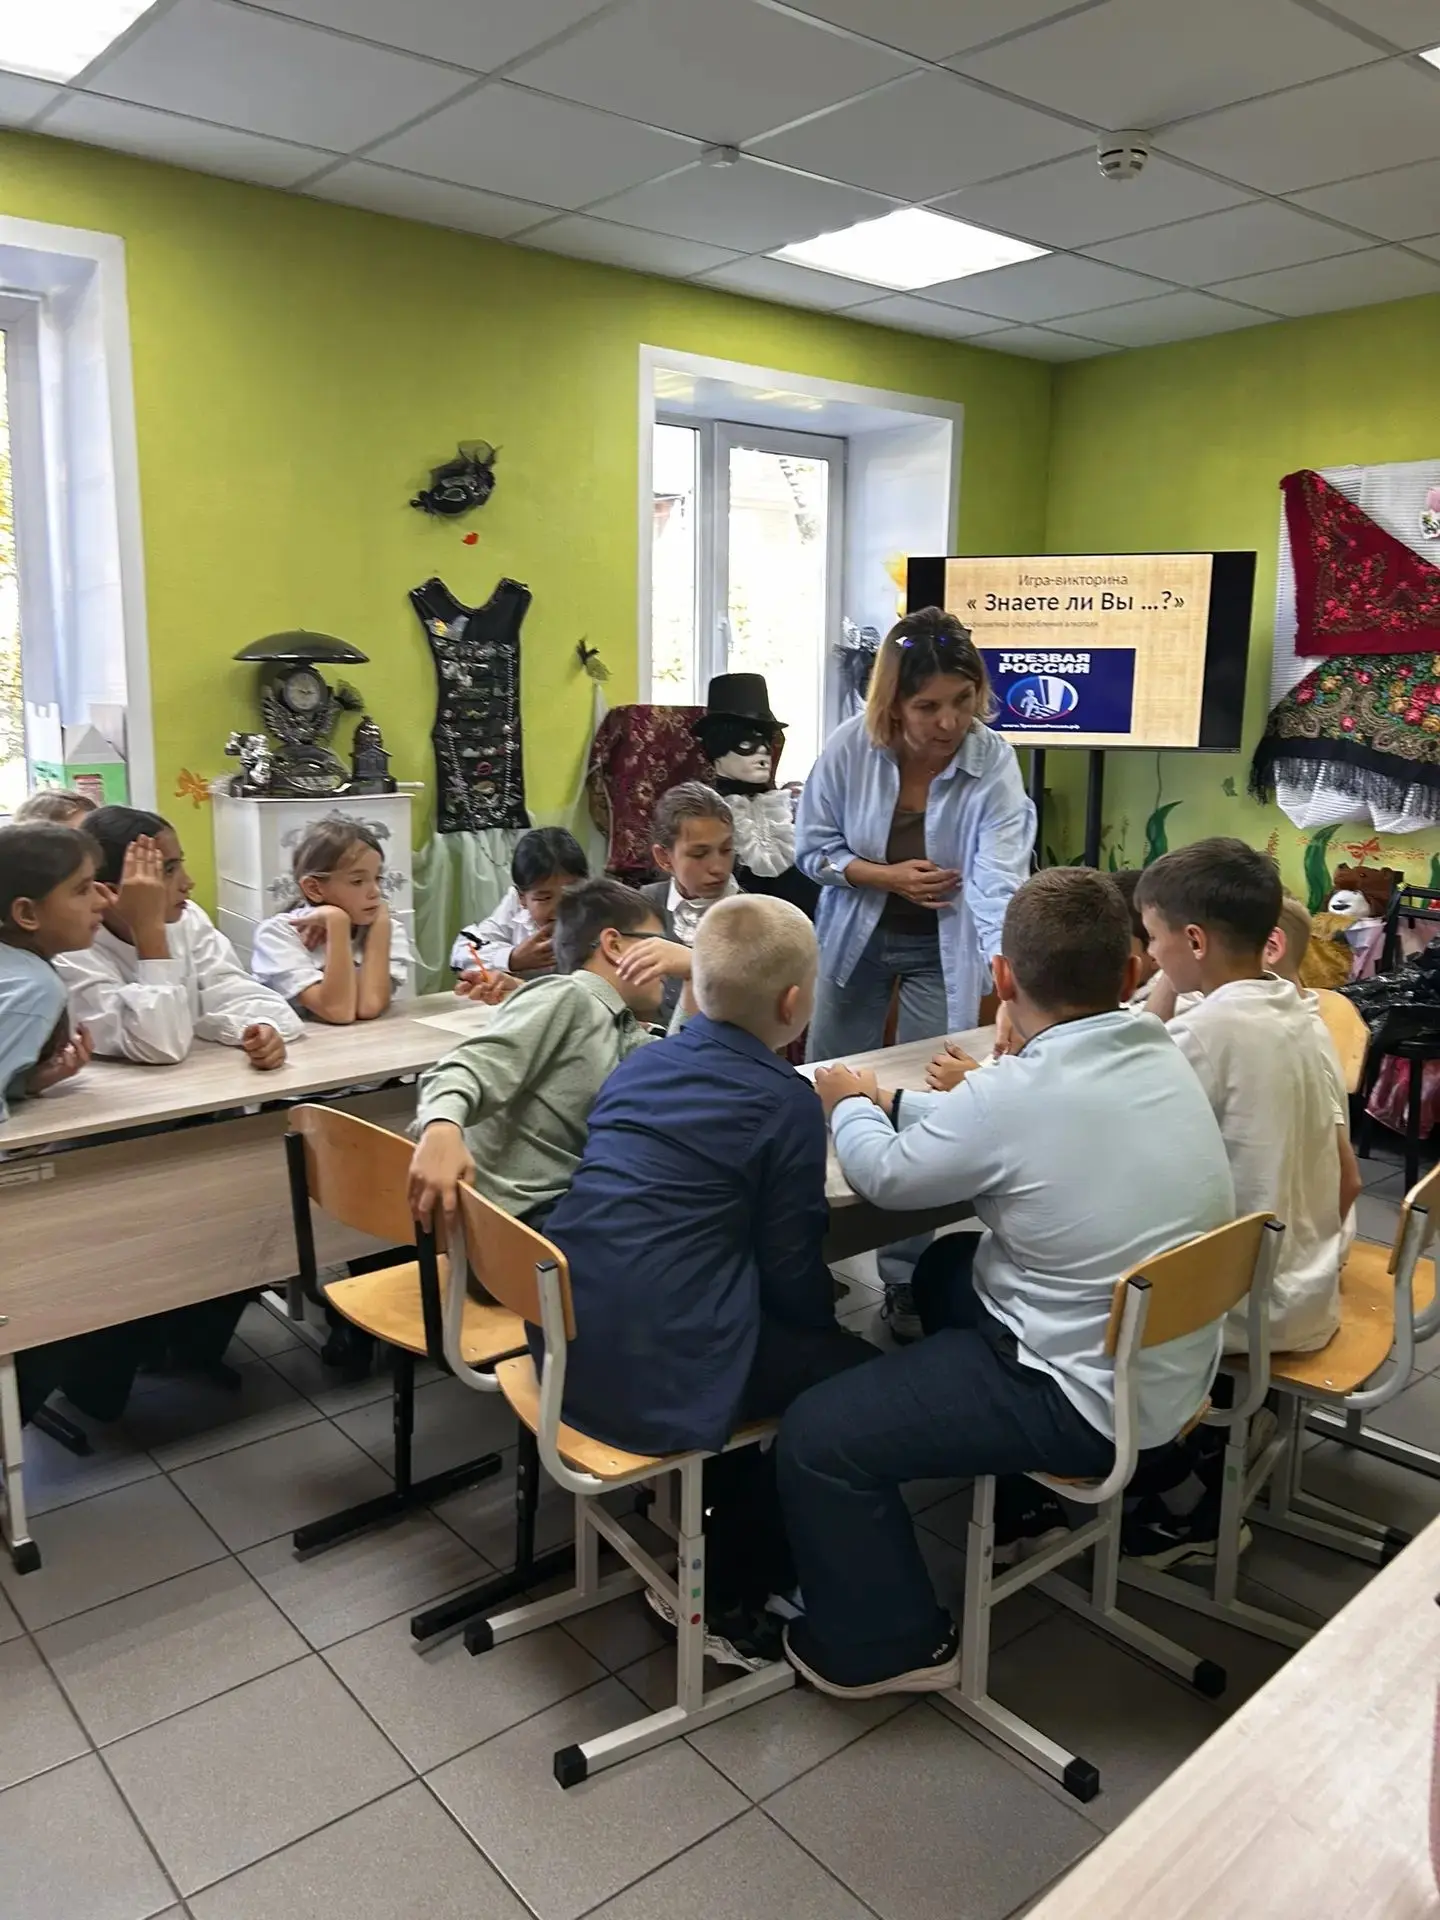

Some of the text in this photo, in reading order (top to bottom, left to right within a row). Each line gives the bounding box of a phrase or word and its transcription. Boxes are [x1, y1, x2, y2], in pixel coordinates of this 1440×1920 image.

[1018, 574, 1129, 587] Игра-викторина
[984, 593, 1060, 611] Знаете
[1065, 597, 1093, 611] ли
[1101, 592, 1133, 610] Вы
[1000, 653, 1091, 663] ТРЕЗВАЯ
[999, 663, 1090, 674] РОССИЯ
